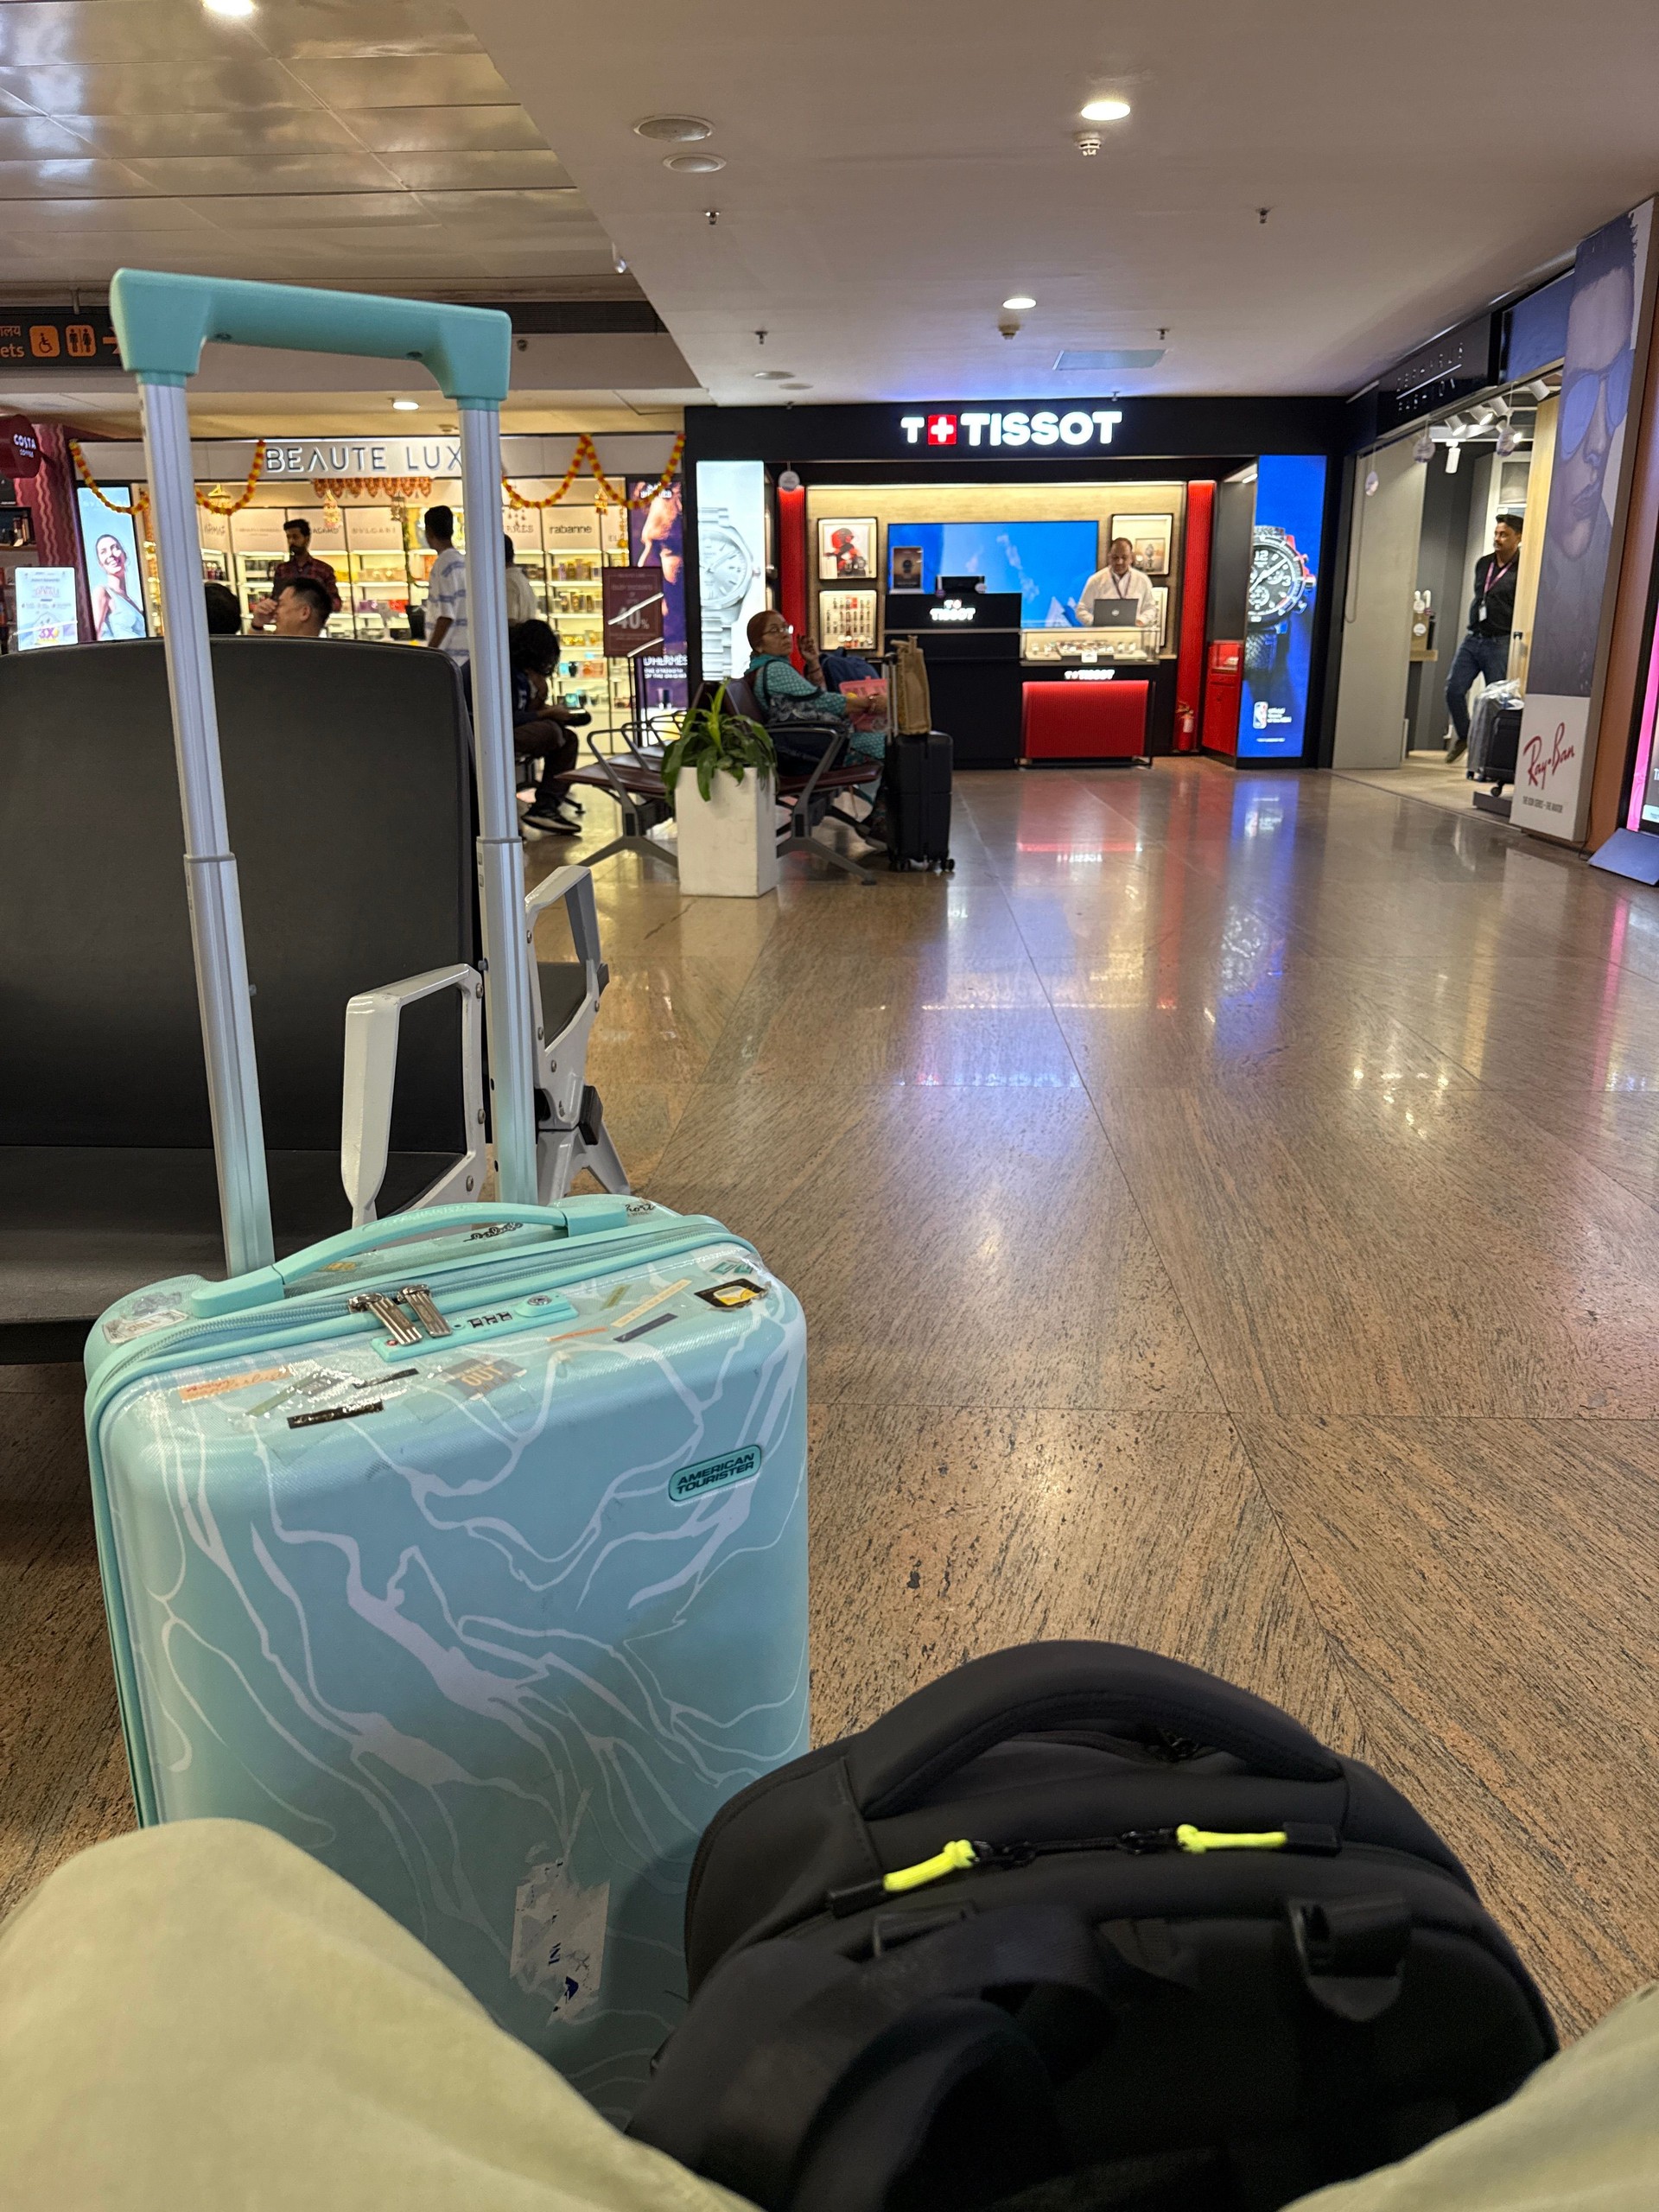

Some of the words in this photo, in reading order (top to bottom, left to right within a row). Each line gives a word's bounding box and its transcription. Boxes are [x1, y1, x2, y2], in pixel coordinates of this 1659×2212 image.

[0, 344, 25, 358] ets
[960, 410, 1122, 447] TISSOT
[13, 434, 36, 449] COSTA
[550, 525, 592, 534] rabanne
[1254, 550, 1269, 562] 12
[929, 607, 976, 620] TISSOT
[1077, 669, 1116, 680] TISSOT
[461, 1364, 503, 1386] OUT
[677, 1452, 755, 1485] AMERICAN
[677, 1461, 755, 1494] TOURISTER
